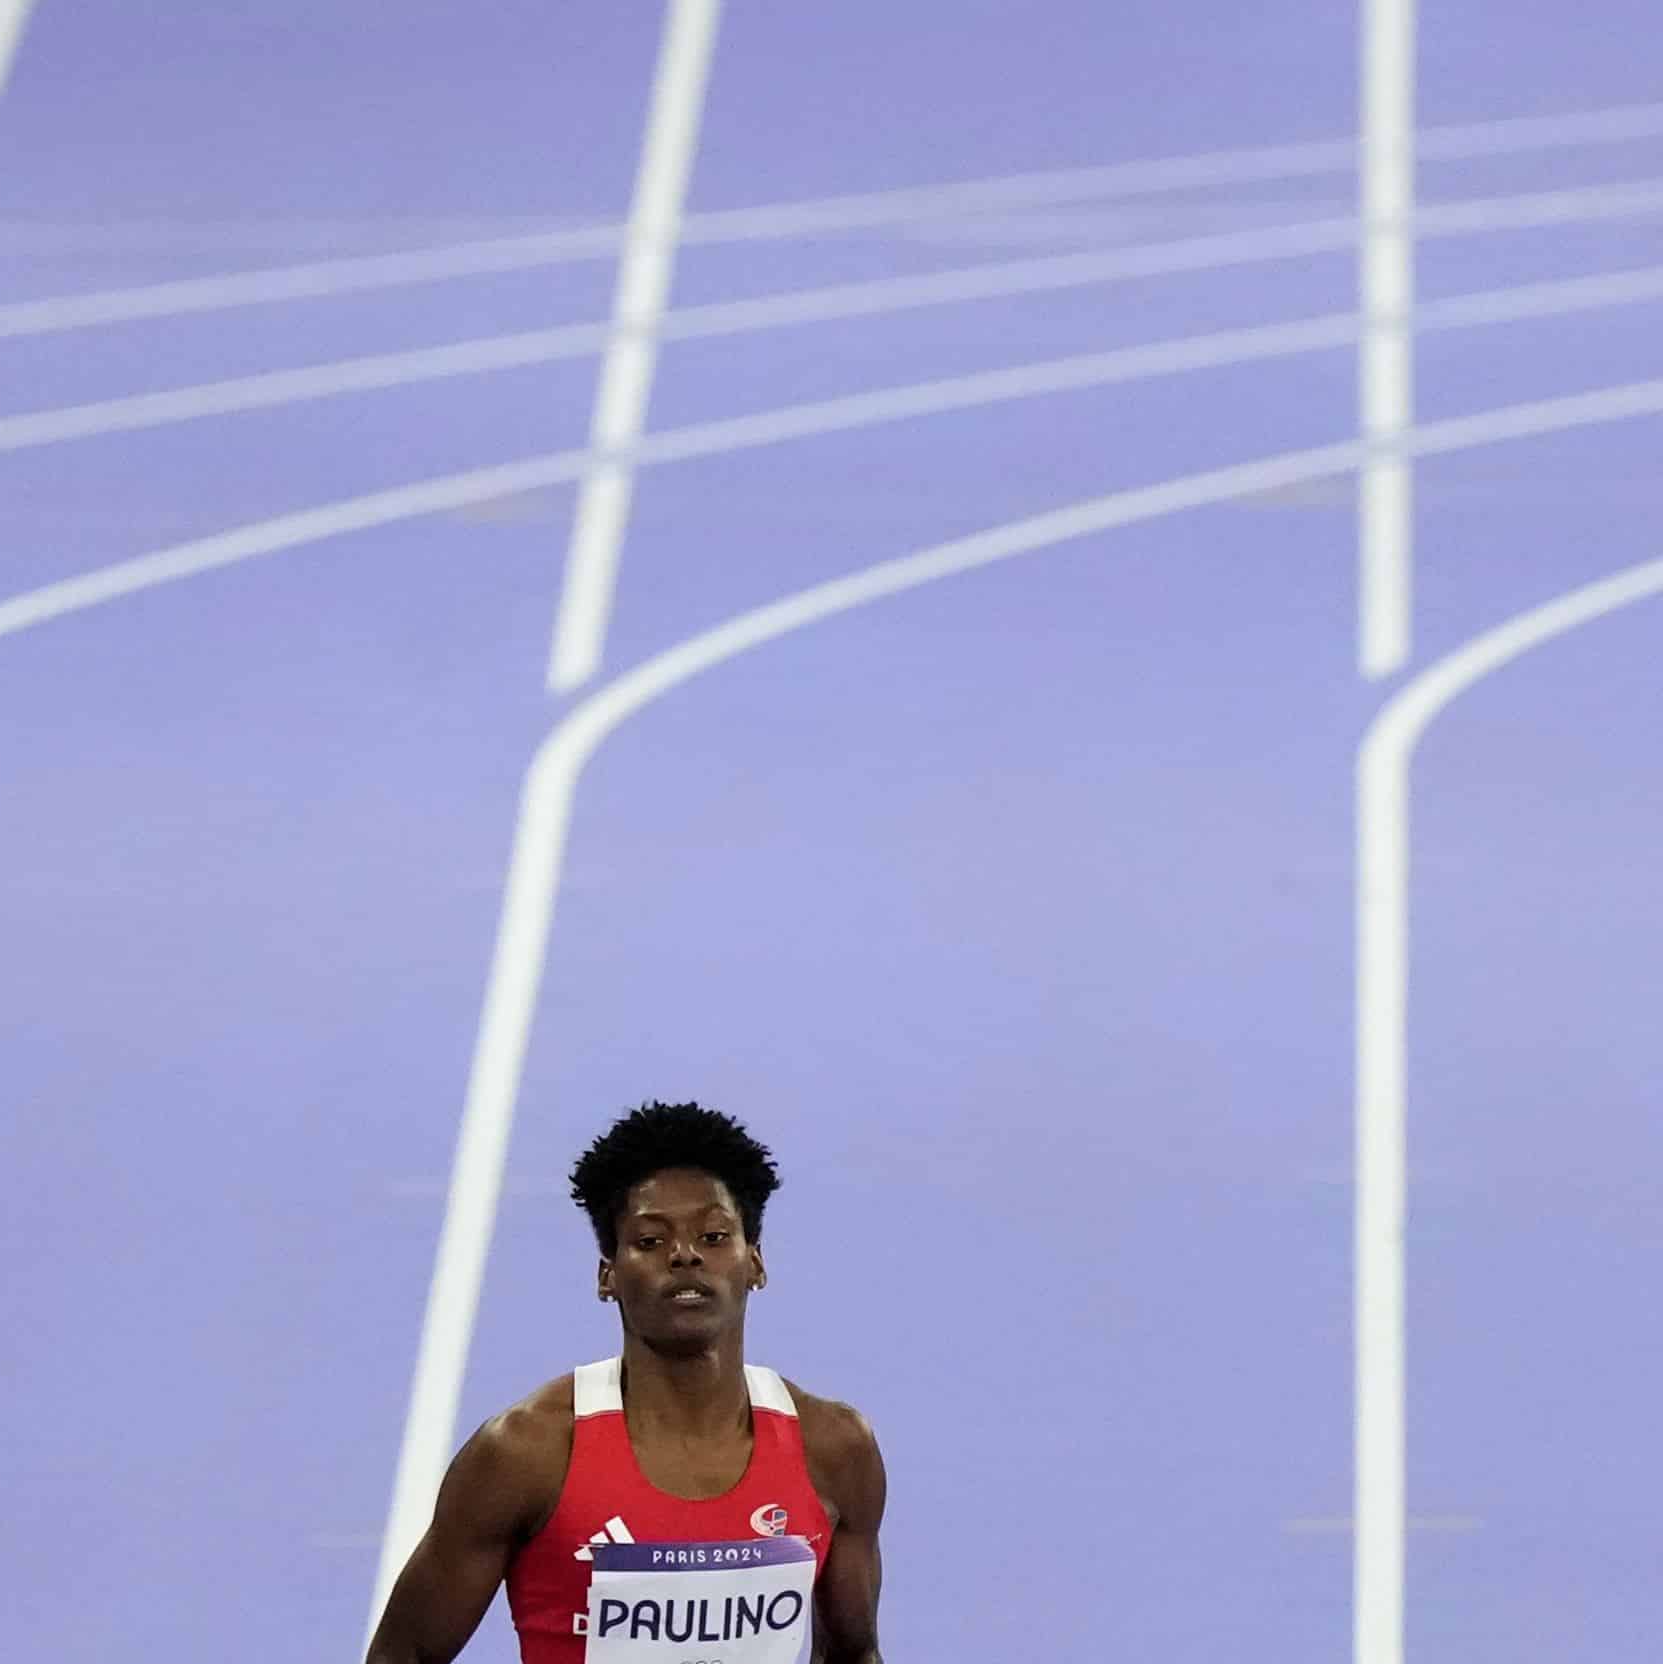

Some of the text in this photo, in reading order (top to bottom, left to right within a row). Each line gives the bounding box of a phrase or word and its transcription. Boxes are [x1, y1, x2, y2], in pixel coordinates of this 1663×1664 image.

[652, 1547, 763, 1564] PARIS 2024
[597, 1590, 803, 1643] PAULINO
